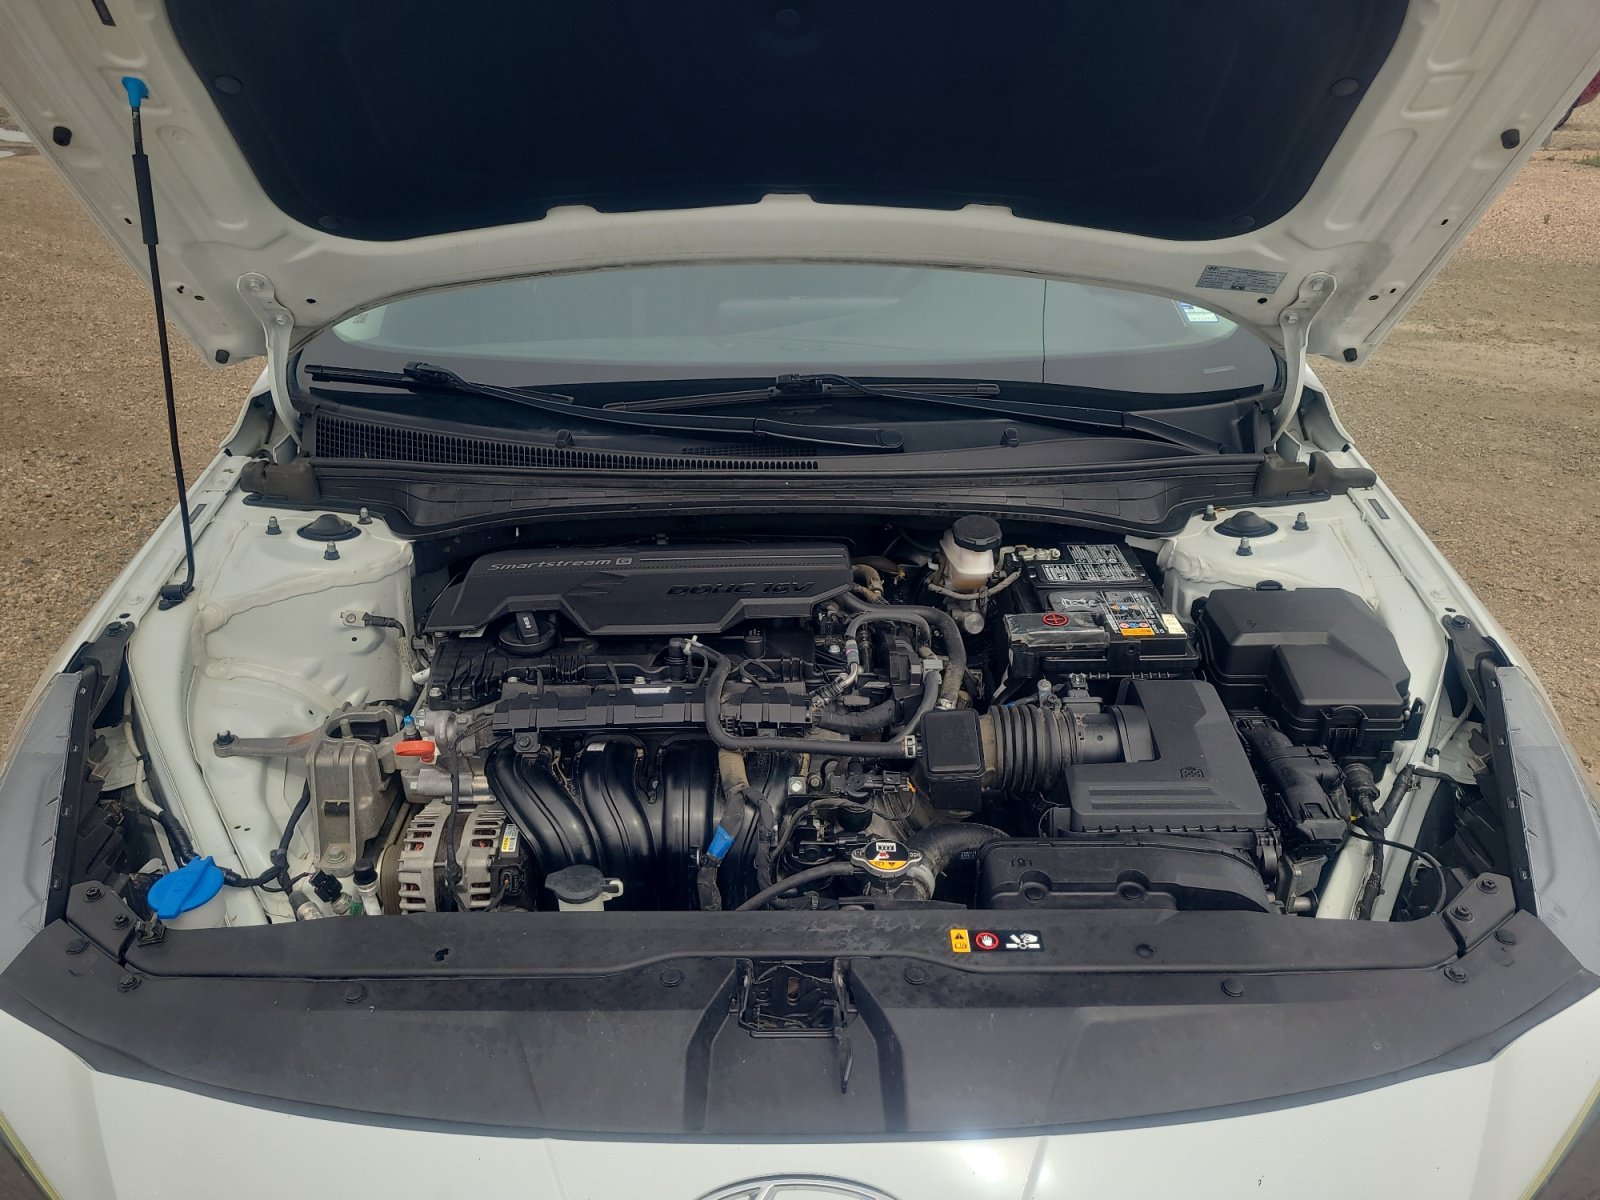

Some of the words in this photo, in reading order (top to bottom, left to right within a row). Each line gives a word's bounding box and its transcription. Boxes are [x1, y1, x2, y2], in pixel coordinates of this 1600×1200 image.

[487, 558, 612, 571] Smartstream
[666, 582, 757, 596] DOHC
[762, 581, 816, 594] 16V
